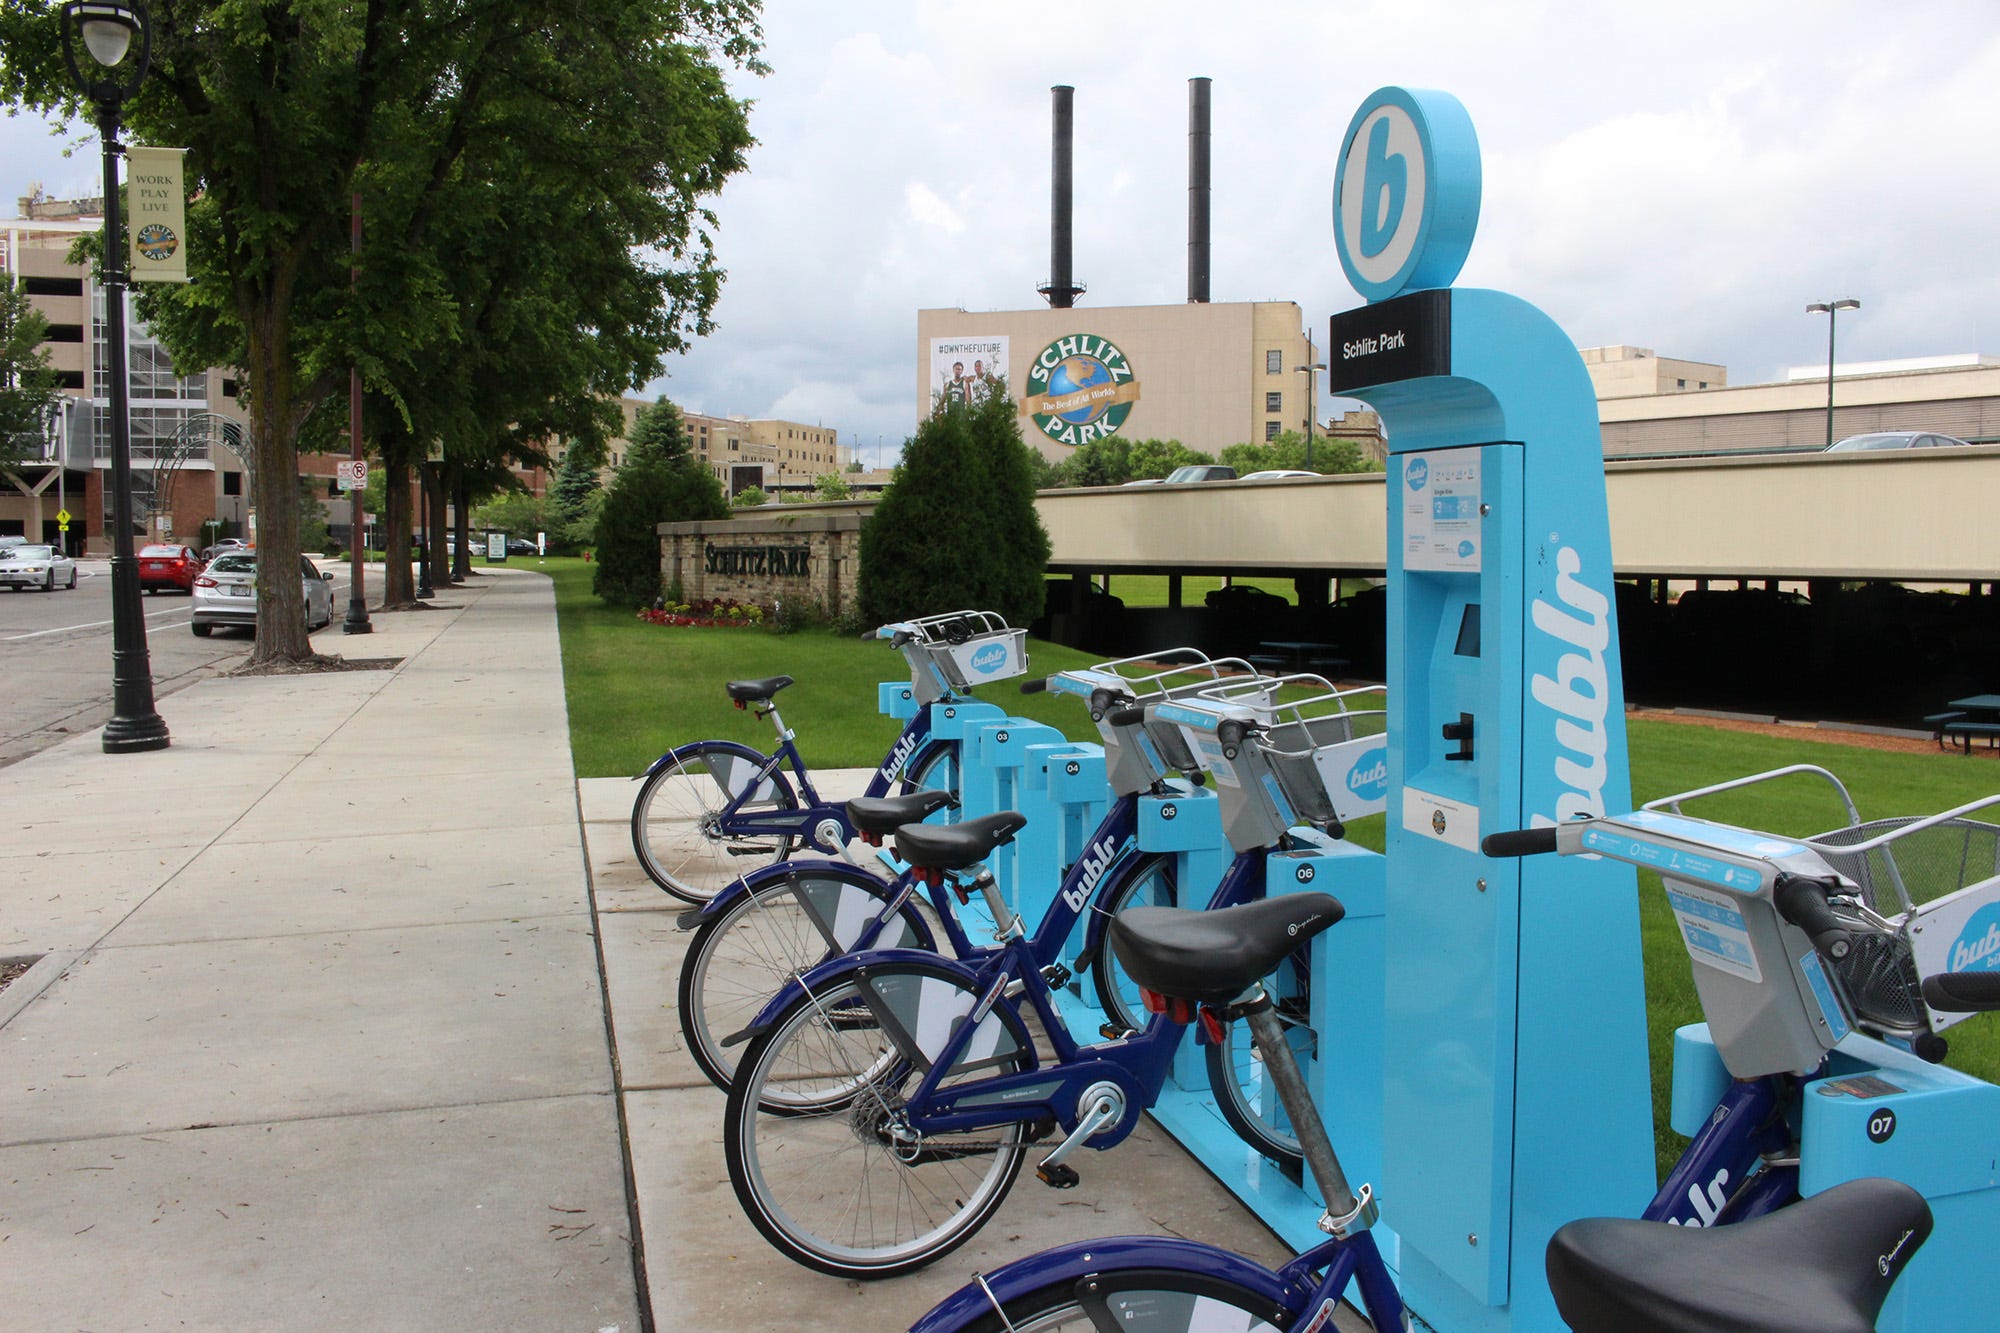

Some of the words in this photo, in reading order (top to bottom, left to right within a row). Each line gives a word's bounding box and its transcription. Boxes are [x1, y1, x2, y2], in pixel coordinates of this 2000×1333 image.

[136, 175, 173, 185] WORK
[141, 189, 169, 198] PLAY
[142, 203, 169, 212] LIVE
[138, 225, 175, 241] SCHLITZ
[144, 250, 171, 260] PARK
[938, 343, 1001, 354] #OWNTHEFUTURE
[1343, 337, 1378, 360] Schlitz
[1379, 329, 1406, 352] Park
[1031, 335, 1131, 383] SCHLITZ
[1042, 401, 1056, 411] The
[1056, 399, 1073, 409] Best
[1091, 387, 1116, 400] Worlds
[1043, 413, 1118, 445] PARK
[704, 541, 767, 575] SCHLITZ
[767, 545, 811, 577] PARK
[997, 733, 1008, 741] 03
[880, 732, 916, 783] bublr
[1066, 764, 1079, 773] 04
[1162, 807, 1176, 817] 05
[1062, 835, 1115, 913] bublr
[1297, 868, 1314, 879] 06
[1870, 1116, 1893, 1135] 07
